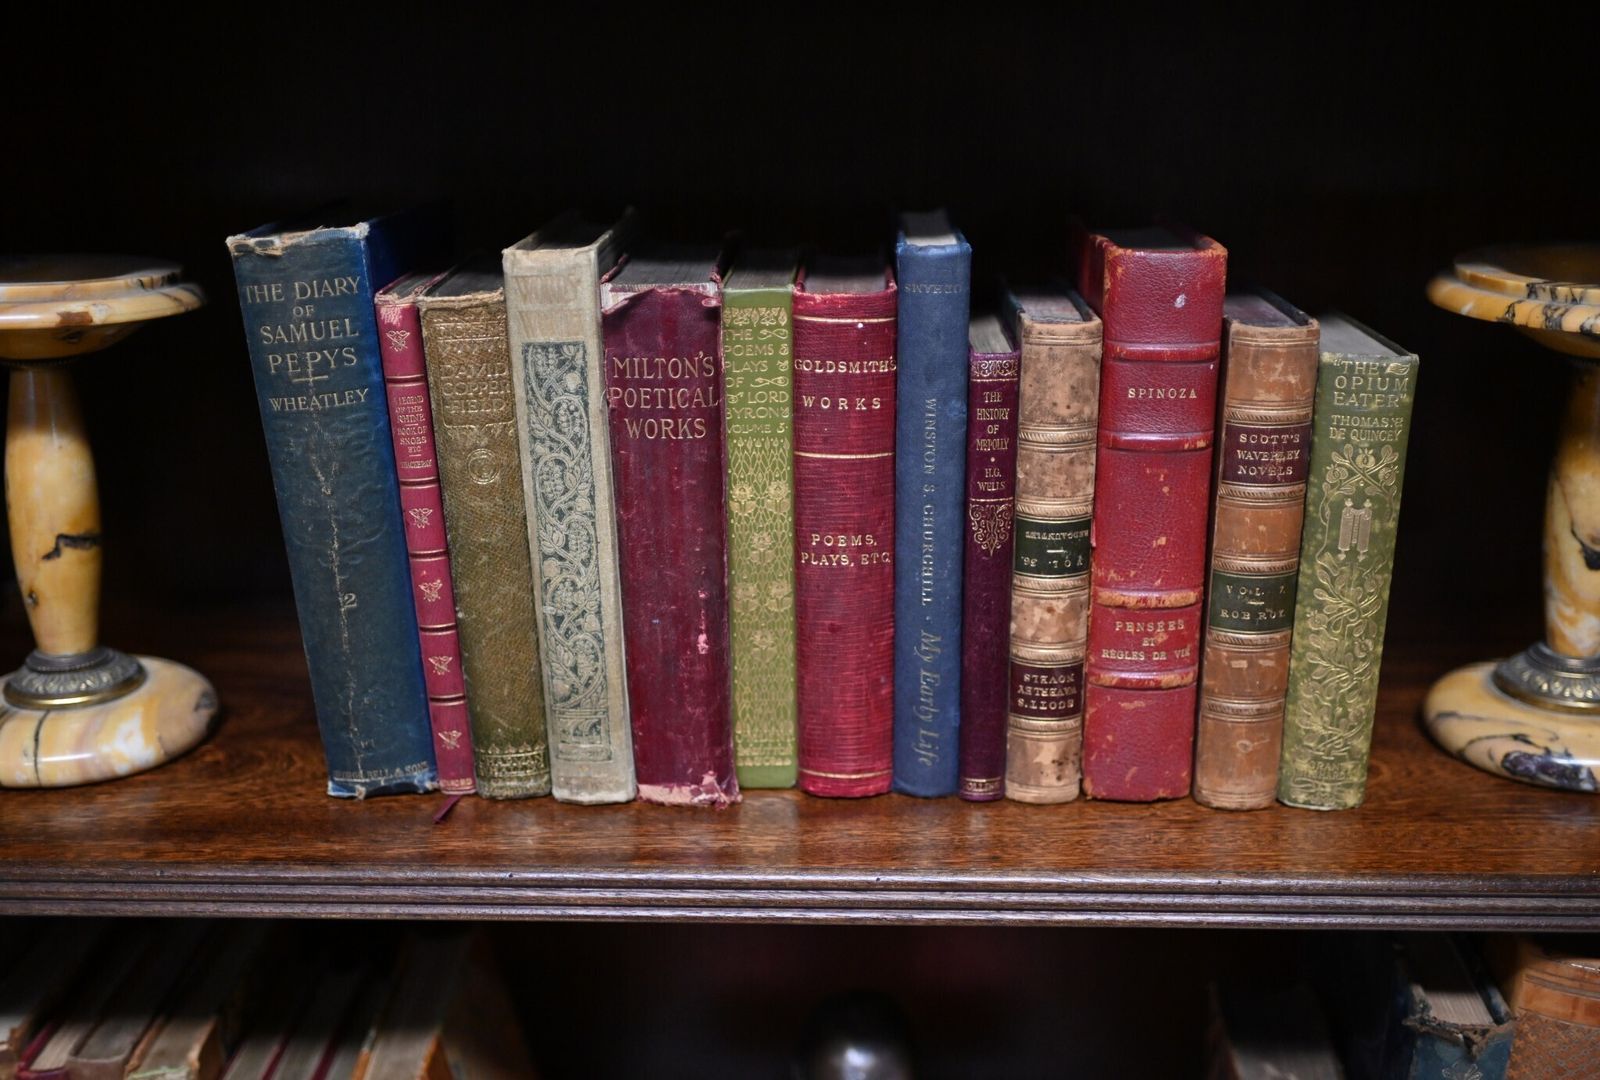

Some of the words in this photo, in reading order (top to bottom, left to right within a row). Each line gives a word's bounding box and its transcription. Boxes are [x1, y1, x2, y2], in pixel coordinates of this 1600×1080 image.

[245, 283, 284, 304] THE
[295, 276, 361, 300] DIARY
[293, 305, 315, 318] OF
[260, 318, 359, 344] SAMUEL
[725, 329, 753, 340] THE
[724, 344, 774, 356] POEMS
[268, 347, 357, 374] PEPYS
[612, 351, 715, 379] MILTON'S
[724, 361, 768, 373] PLAYS
[794, 355, 897, 373] GOLDSMITH'S
[726, 377, 744, 388] OF
[1335, 376, 1409, 392] OPIUM
[269, 388, 368, 411] WHEATLEY
[608, 386, 718, 409] POETICAL
[747, 391, 789, 404] LORD
[984, 391, 1003, 403] THE
[1128, 388, 1197, 399] SPINOZA
[407, 405, 423, 413] THE
[802, 395, 881, 411] WORKS
[397, 413, 425, 424] RHINE
[726, 406, 779, 419] BYRON
[976, 408, 1010, 420] HISTORY
[1331, 414, 1391, 428] THOMAS
[624, 418, 707, 439] WORKS
[727, 424, 771, 434] VOLUME
[987, 425, 999, 434] OF
[1329, 427, 1346, 440] DE
[1350, 429, 1402, 442] QUINCEY
[924, 398, 937, 475] WINSTON
[1239, 434, 1300, 445] SCOTT'S
[1237, 449, 1300, 462] WAVERLEY
[985, 468, 1002, 478] H.G.
[1238, 466, 1293, 477] NOVELS
[923, 484, 936, 497] S.
[977, 481, 1005, 491] WELLS
[922, 504, 934, 606] CHURCHILL
[1226, 585, 1265, 597] VOL.
[1220, 608, 1250, 621] ROB
[914, 629, 942, 663] My
[1142, 637, 1156, 647] ET
[1152, 651, 1167, 660] DE
[1023, 673, 1075, 684] NOVELS
[913, 668, 940, 722] Early
[1018, 685, 1076, 697] WAVERLEY
[1018, 699, 1075, 710] SCOTT'S
[913, 728, 940, 767] Life
